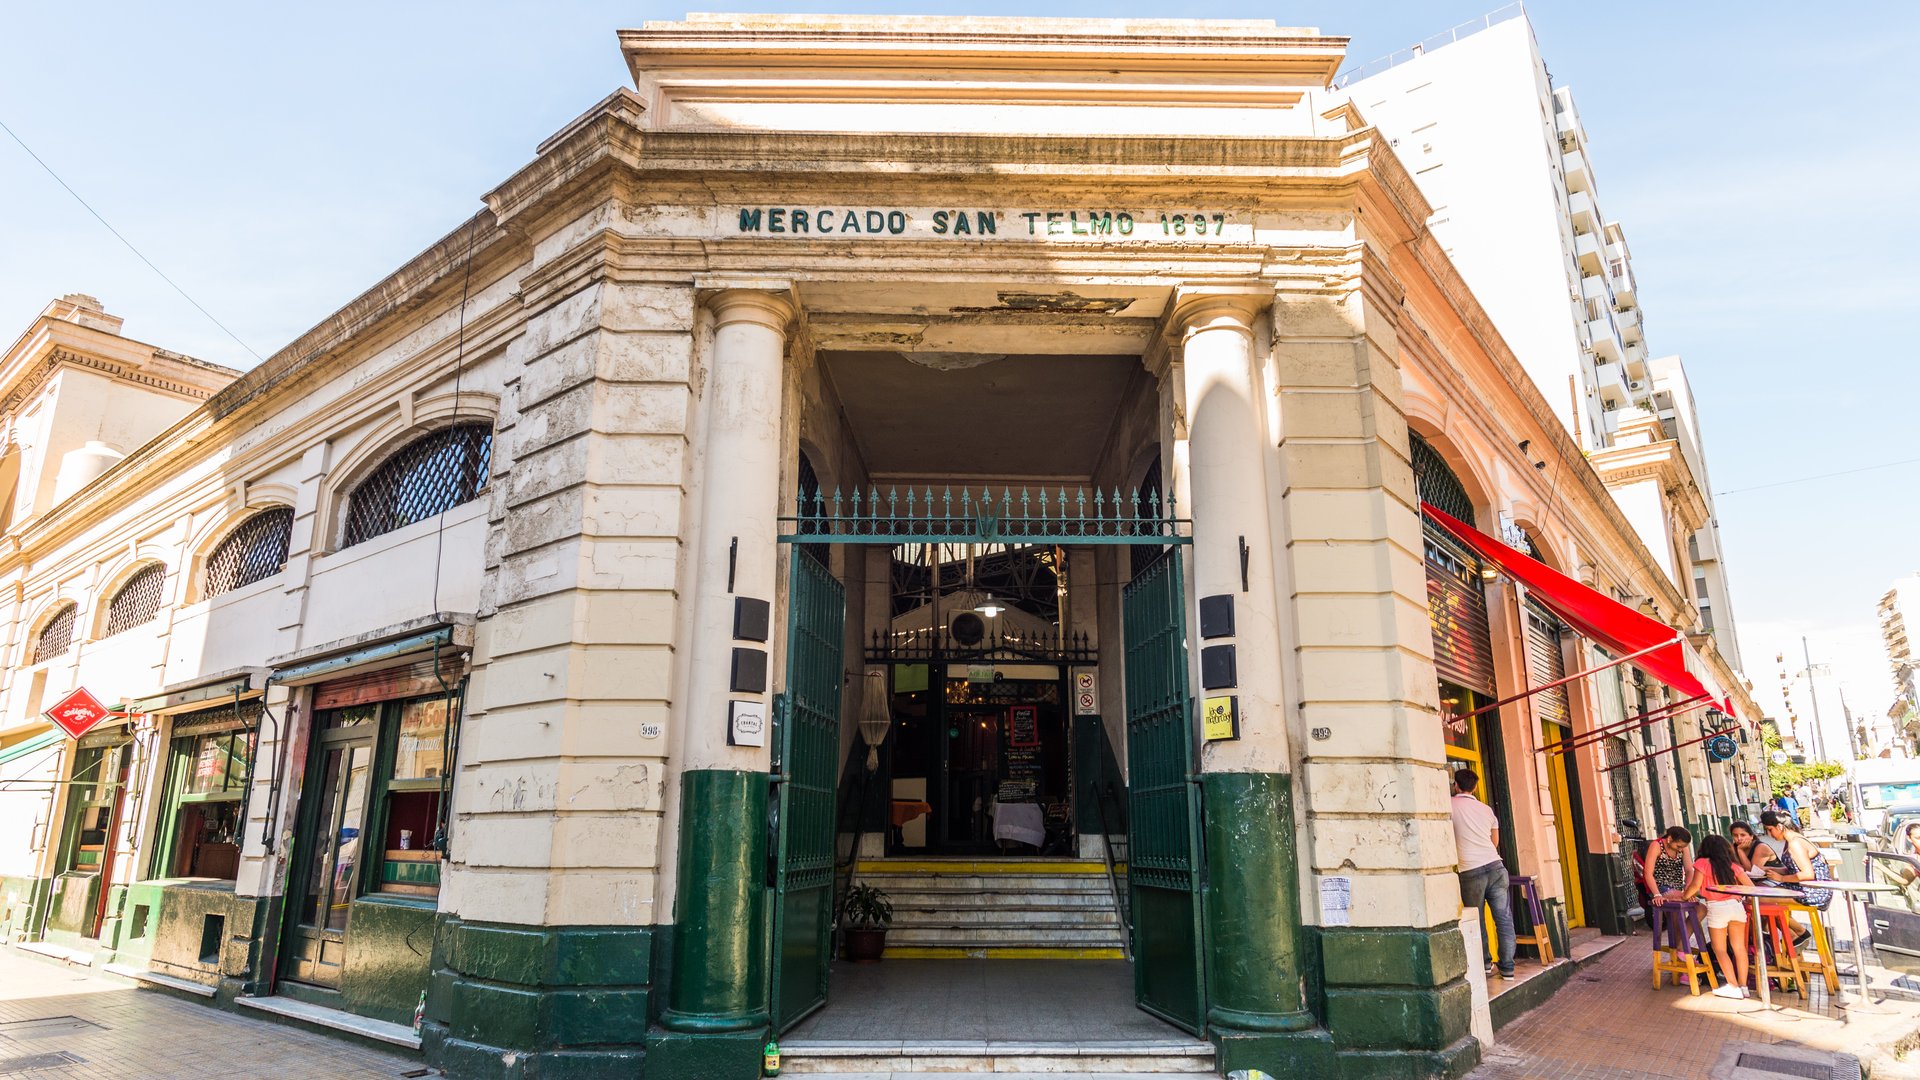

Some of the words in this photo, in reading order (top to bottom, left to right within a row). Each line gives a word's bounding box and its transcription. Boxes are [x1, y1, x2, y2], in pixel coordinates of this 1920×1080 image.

[738, 208, 906, 235] MERCADO
[932, 210, 997, 236] SAN
[1022, 210, 1134, 235] TELMO
[1160, 213, 1225, 236] 1897
[642, 725, 658, 736] 998
